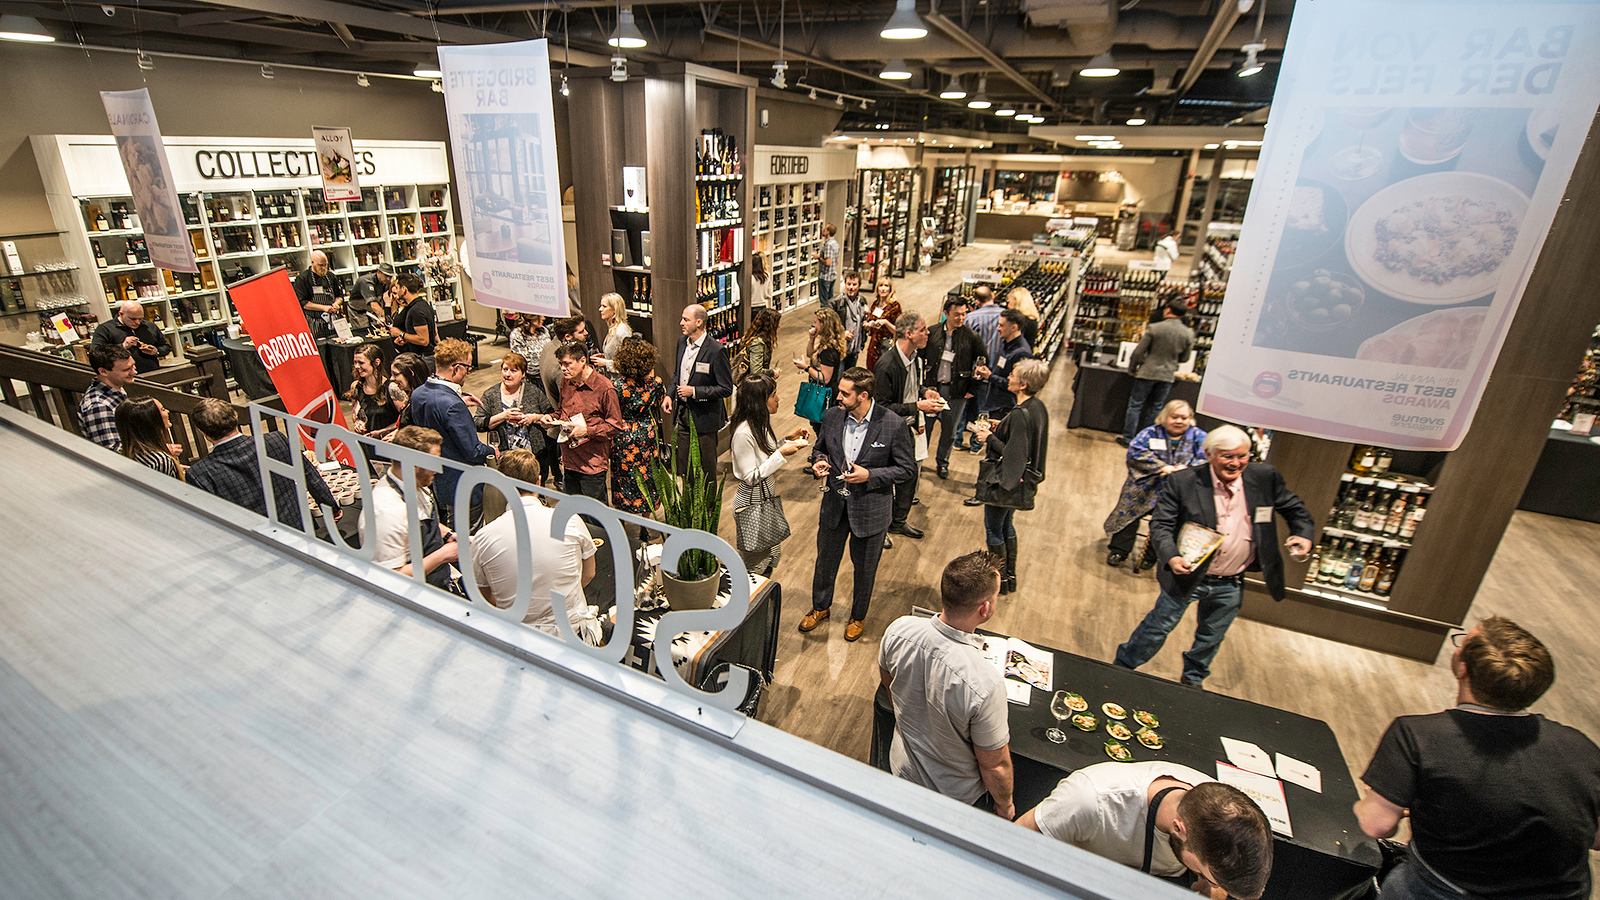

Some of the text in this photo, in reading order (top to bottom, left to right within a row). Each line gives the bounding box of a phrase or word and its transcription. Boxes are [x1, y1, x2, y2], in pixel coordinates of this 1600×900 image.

[321, 134, 343, 142] ALLOY
[195, 150, 376, 180] COLLECTIES
[771, 155, 809, 175] FORTIFIED
